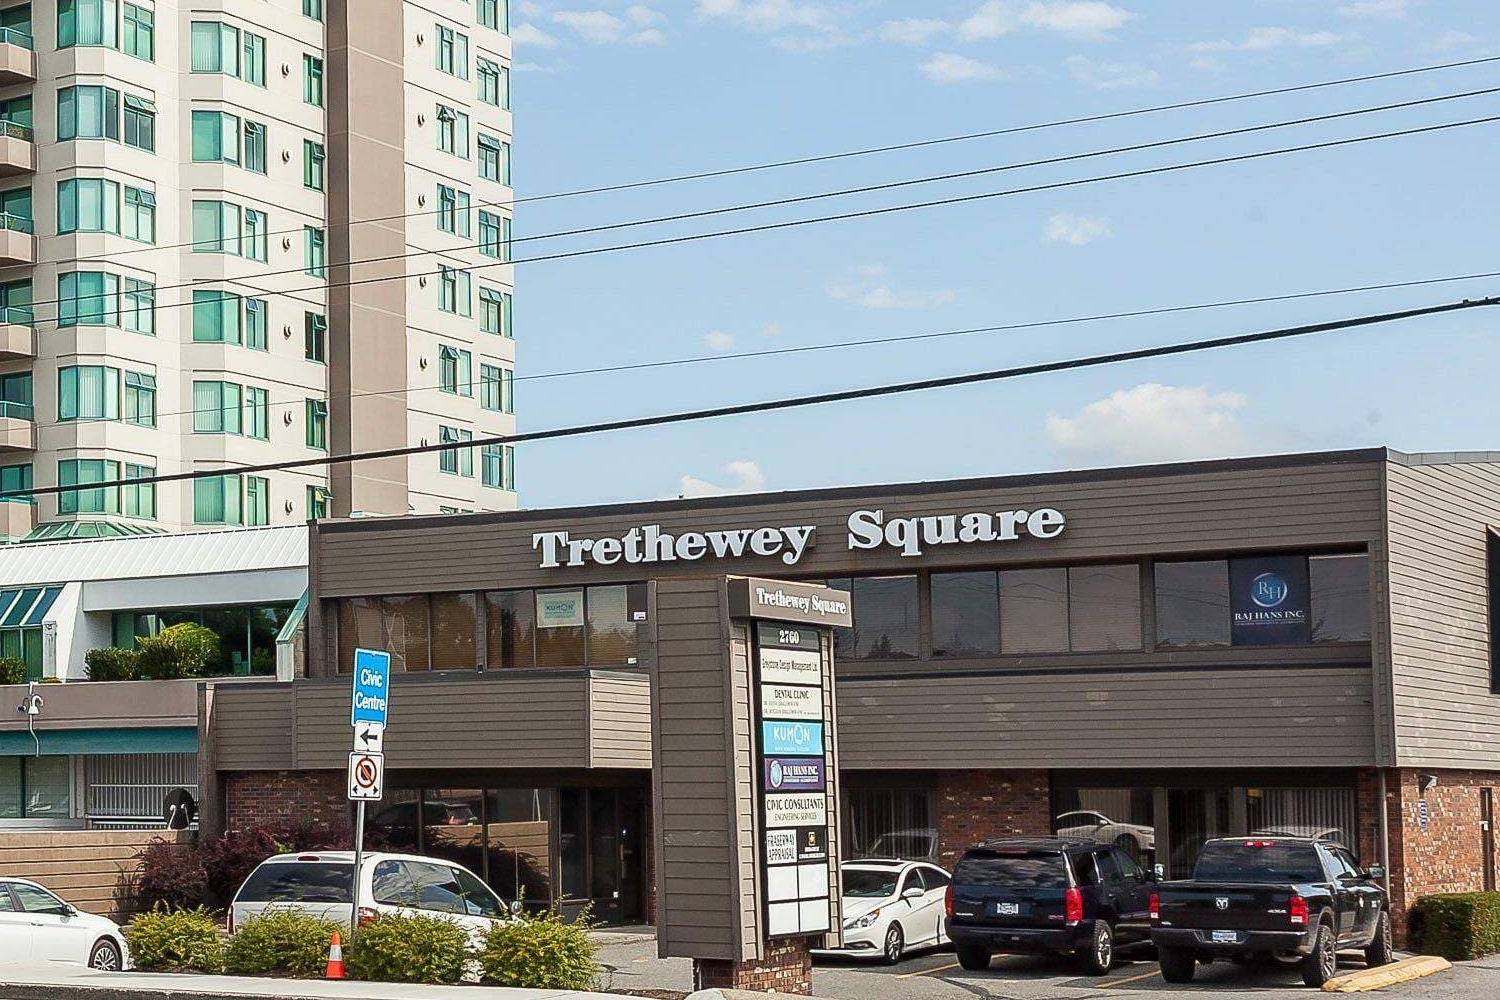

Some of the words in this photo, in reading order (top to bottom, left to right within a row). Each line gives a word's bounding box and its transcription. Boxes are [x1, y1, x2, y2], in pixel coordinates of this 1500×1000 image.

[532, 523, 816, 568] Trethewey
[847, 507, 1067, 557] Square
[546, 603, 574, 612] KUMON
[756, 587, 810, 614] Trethewey
[811, 594, 847, 616] Square
[1235, 612, 1252, 621] RAJ
[1255, 611, 1283, 620] HANS
[1284, 610, 1305, 618] INC.
[779, 629, 800, 644] 2760
[360, 668, 383, 688] Civic
[355, 691, 386, 711] Centre
[774, 689, 793, 699] DENTAL
[794, 690, 809, 700] CLINIC
[773, 724, 811, 745] KUMON
[782, 765, 793, 776] RAJ
[793, 765, 807, 776] HANS
[766, 799, 783, 811] CIVIC
[784, 798, 824, 810] CONSULTANTS
[774, 813, 801, 821] ENGINEERING
